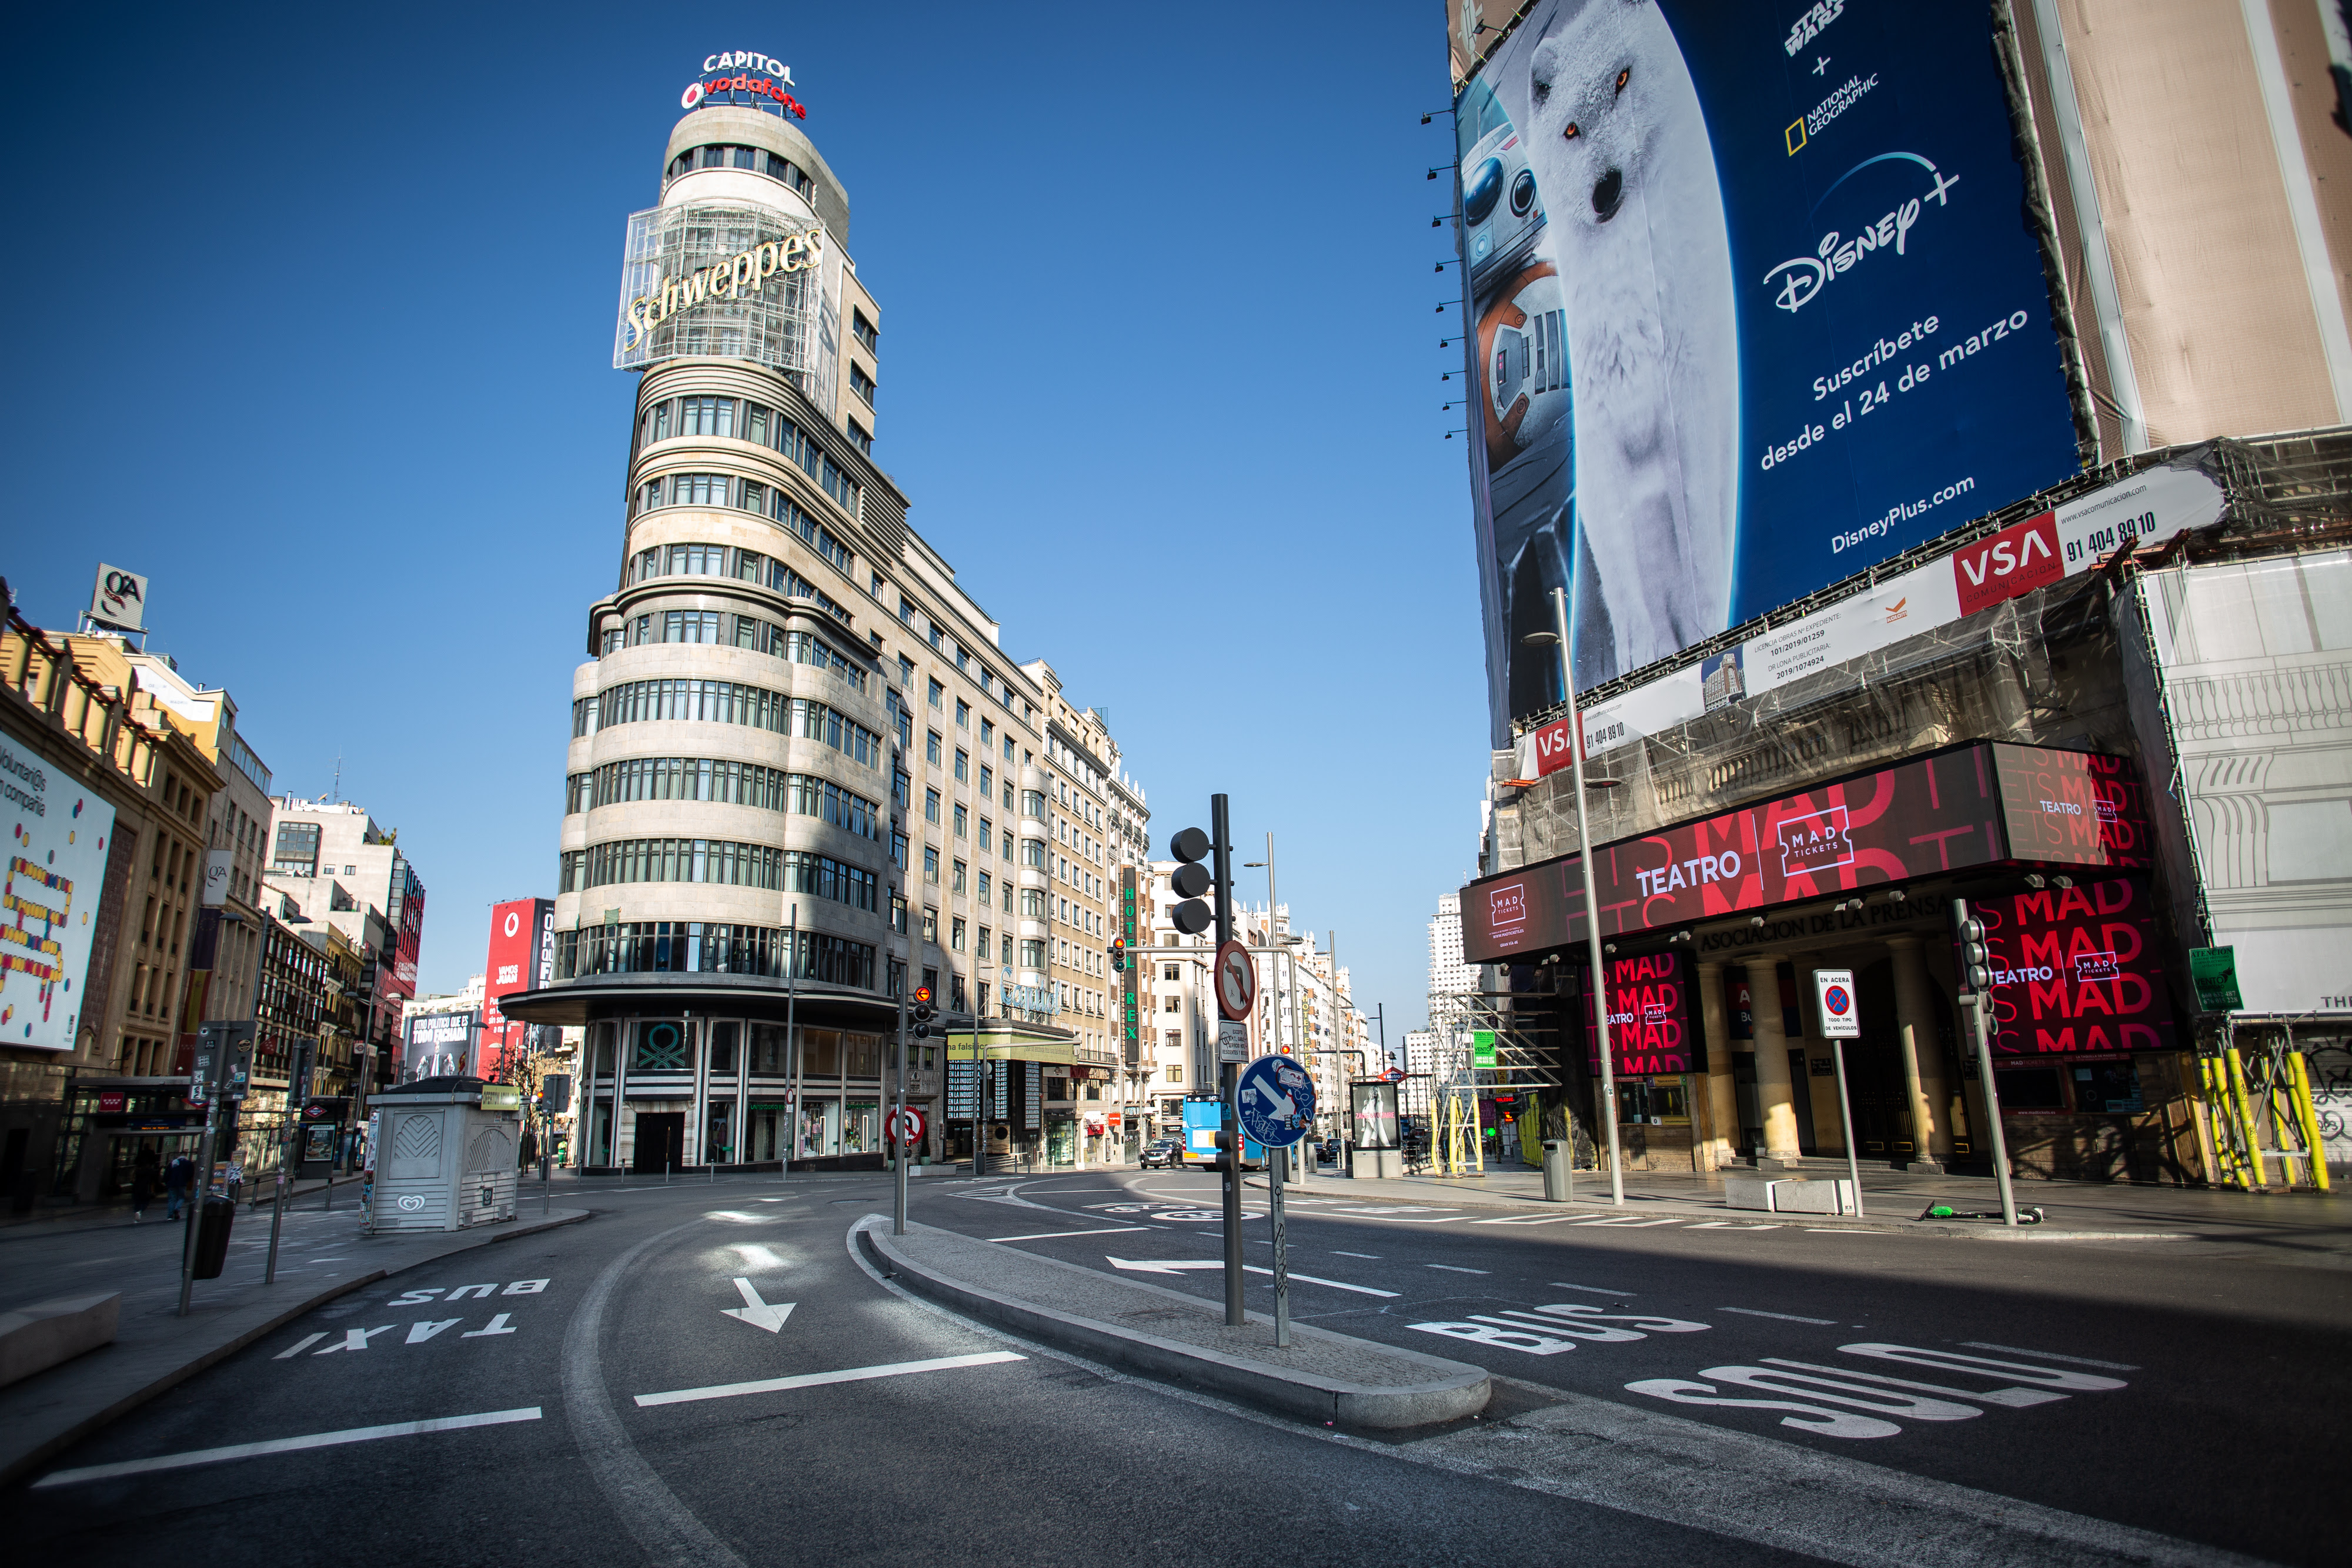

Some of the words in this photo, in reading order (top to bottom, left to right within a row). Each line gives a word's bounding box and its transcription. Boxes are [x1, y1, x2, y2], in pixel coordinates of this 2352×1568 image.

[1786, 0, 1846, 57] WARS
[703, 51, 795, 86] CAPITOL
[706, 73, 806, 120] vodafone
[1808, 75, 1861, 124] NATIONAL
[1809, 73, 1879, 136] GEOGRAPHIC
[624, 229, 821, 352] Schweppes
[1813, 316, 1939, 401] Suscríbete
[1762, 424, 1825, 470] desde
[1832, 401, 1852, 431] el
[1859, 381, 1889, 415] 24
[1898, 363, 1930, 393] de
[1939, 310, 2027, 370] marzo
[1832, 477, 1975, 554] DisneyPlus.com
[2061, 484, 2146, 524] www.vsacomunicacion.com
[2067, 539, 2083, 562] 91
[2089, 527, 2114, 553] 404
[2117, 519, 2137, 543] 89
[2137, 511, 2156, 535] 10
[1961, 530, 2052, 586] VSA
[1966, 561, 2056, 603] COMUNICACION
[1755, 638, 1778, 653] LICENCIA
[1778, 630, 1797, 643] OBRAS
[1806, 613, 1842, 632] EXPEDIENTE:
[1770, 630, 1825, 657] 101/2019/01259
[1768, 663, 1776, 672] DR
[1776, 657, 1792, 669] LONA
[1792, 643, 1831, 663] PUBLICITARIA:
[1776, 656, 1824, 680] 2019/1074924
[1586, 735, 1594, 749] 91
[1595, 728, 1607, 745] 404
[1608, 725, 1617, 740] 89
[1616, 722, 1625, 737] 10
[2040, 800, 2081, 815] TEATRO
[1792, 826, 1837, 848] MAD
[1794, 841, 1839, 858] TICKETS
[1636, 850, 1742, 897] TEATRO
[1497, 895, 1518, 909] MAD
[1498, 905, 1519, 915] TICKETS
[1125, 888, 1135, 968] HOTEL
[1703, 918, 1805, 951] ASOCIACION
[1812, 914, 1835, 933] DE
[1841, 910, 1863, 928] LA
[1871, 894, 1947, 924] PRENSA
[2021, 922, 2142, 971] MAD
[2083, 960, 2110, 970] MAD
[2191, 948, 2232, 958] ATENCIÓN
[496, 974, 518, 985] JUAN
[499, 965, 518, 975] VAMOS
[1616, 952, 1675, 984] MAD
[1991, 967, 2052, 985] TEATRO
[1000, 967, 1062, 1019] Capitol
[1618, 983, 1678, 1015] MAD
[2029, 972, 2152, 1020] MAD
[414, 1018, 427, 1029] OTRO
[450, 1016, 461, 1028] QUE
[461, 1015, 469, 1027] ES
[1126, 992, 1137, 1039] REX
[1606, 1012, 1633, 1025] EATRO
[413, 1029, 433, 1044] TODO
[433, 1027, 467, 1044] FACHADA
[1621, 1018, 1681, 1051] MAD
[1331, 1206, 1463, 1214] BUS
[387, 1278, 551, 1306] BUS
[272, 1313, 517, 1359] TAXI
[1405, 1303, 1712, 1356] BUS
[1624, 1342, 2129, 1438] SOLO
